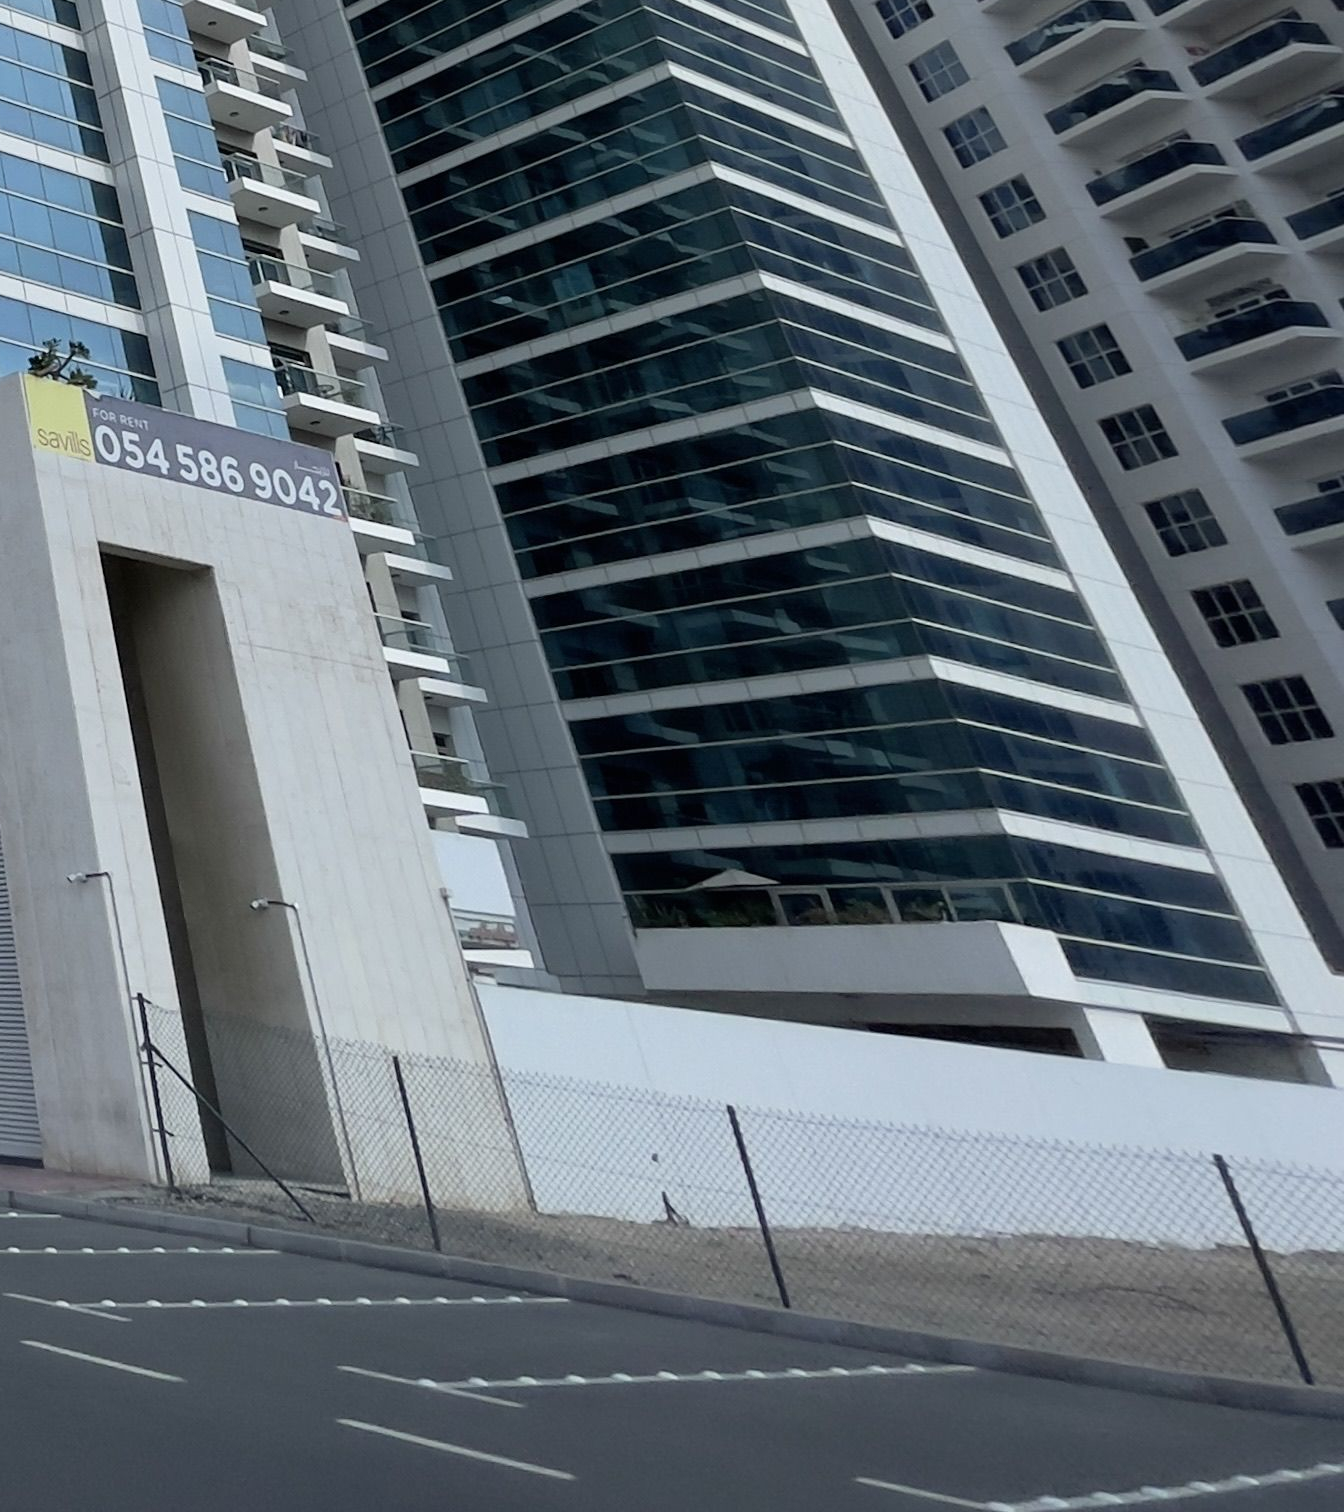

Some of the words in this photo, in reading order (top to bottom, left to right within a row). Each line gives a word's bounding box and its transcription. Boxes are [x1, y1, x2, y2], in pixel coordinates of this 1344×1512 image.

[93, 407, 117, 424] FOR
[120, 414, 149, 431] RENT
[37, 428, 91, 457] savills
[94, 424, 170, 476] 054
[176, 443, 244, 493] 586
[249, 462, 342, 516] 9042
